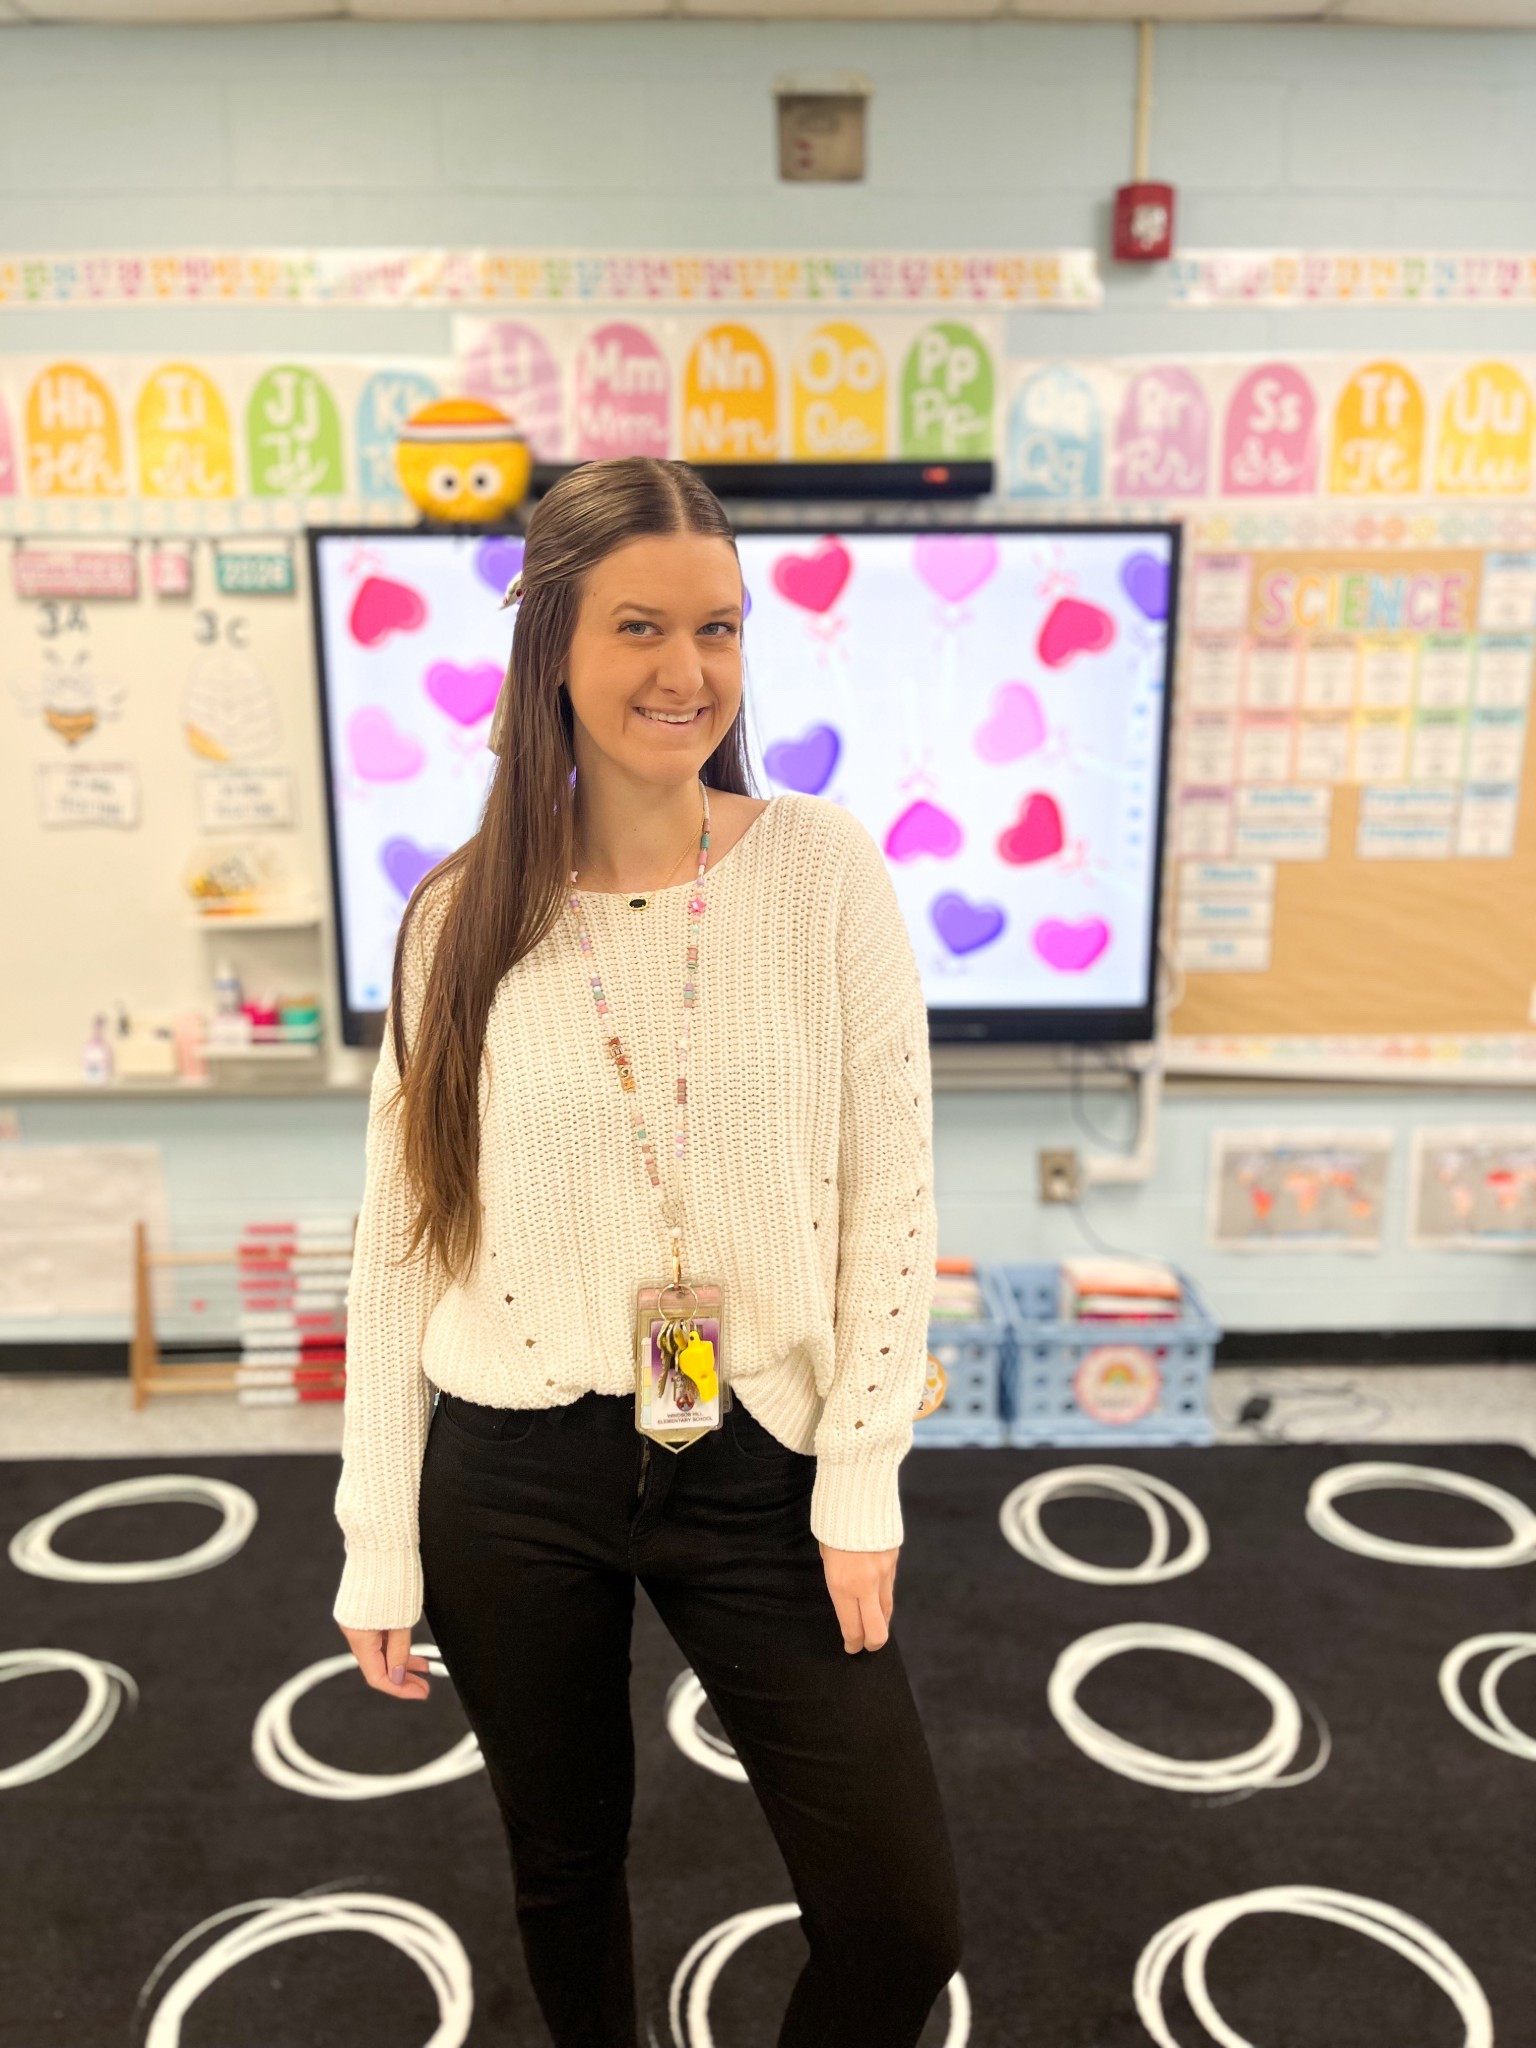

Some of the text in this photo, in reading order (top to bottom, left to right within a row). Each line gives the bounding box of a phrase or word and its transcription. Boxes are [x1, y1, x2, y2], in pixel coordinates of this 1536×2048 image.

[583, 340, 666, 394] Mm
[696, 333, 764, 391] Nn
[799, 337, 881, 395] Oo
[917, 329, 981, 399] Pp
[39, 374, 105, 431] Hh
[262, 373, 321, 442] Jj
[911, 388, 988, 457] Pp
[1137, 375, 1193, 432] Rr
[1247, 378, 1303, 433] Ss
[1358, 373, 1410, 429] Tt
[1452, 376, 1526, 433] Uu
[1017, 429, 1086, 499] Qq
[1262, 570, 1468, 631] SCIENCE
